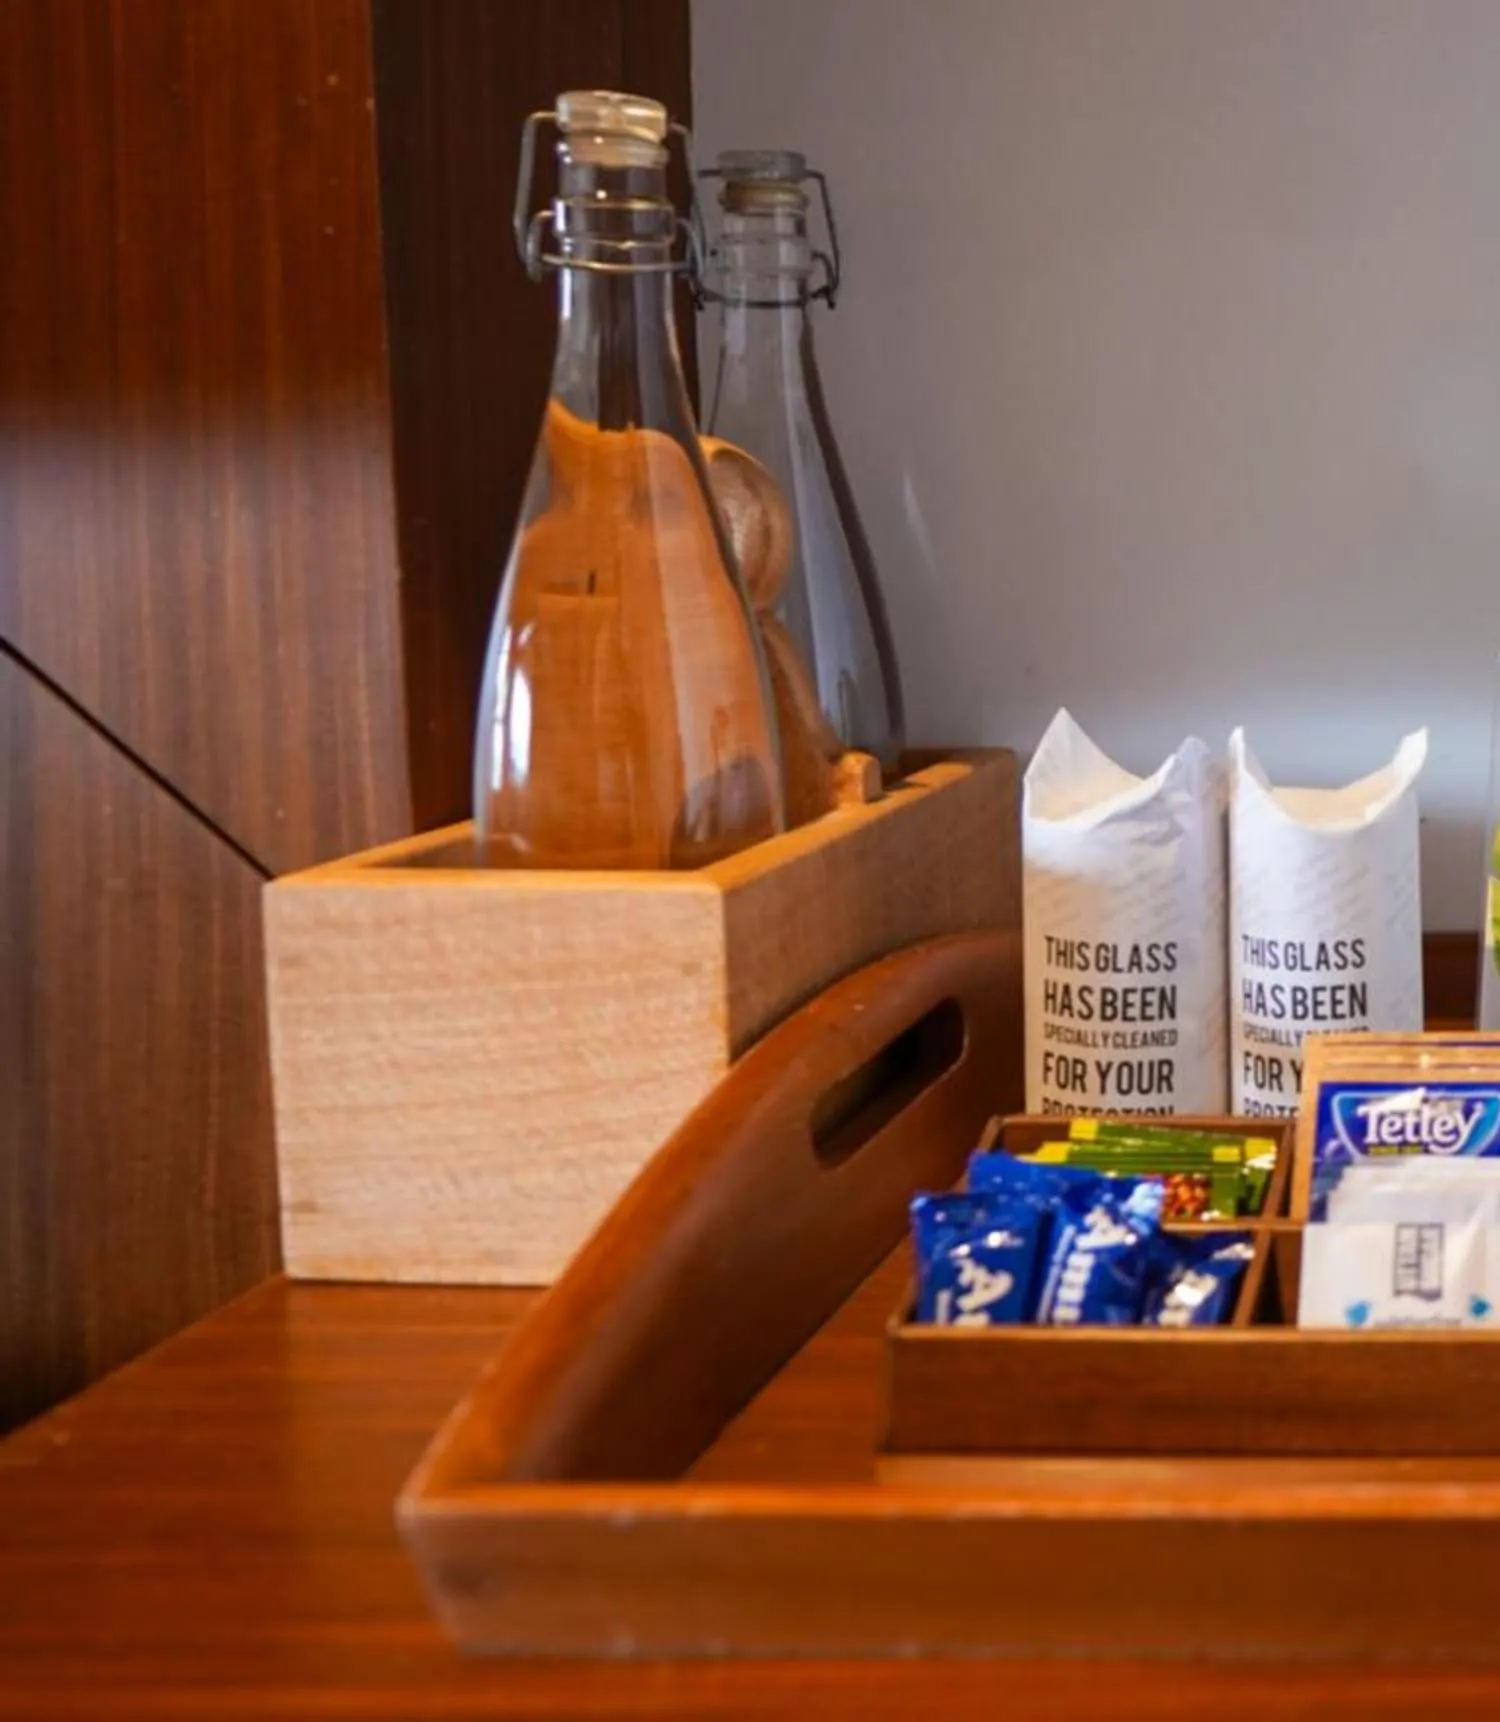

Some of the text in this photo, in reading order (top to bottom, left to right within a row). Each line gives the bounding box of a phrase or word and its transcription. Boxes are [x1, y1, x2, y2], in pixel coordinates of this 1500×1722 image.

[1044, 935, 1178, 973] THIS GLASS
[1242, 934, 1366, 972] THIS GLASS
[1044, 978, 1177, 1022] HAS BEEN
[1242, 978, 1368, 1021] HAS BEEN
[1044, 1022, 1178, 1049] SPECIALLY CLEANED
[1043, 1050, 1174, 1096] FOR YOUR
[1243, 1051, 1284, 1093] FOR
[1357, 1086, 1484, 1155] Tetley
